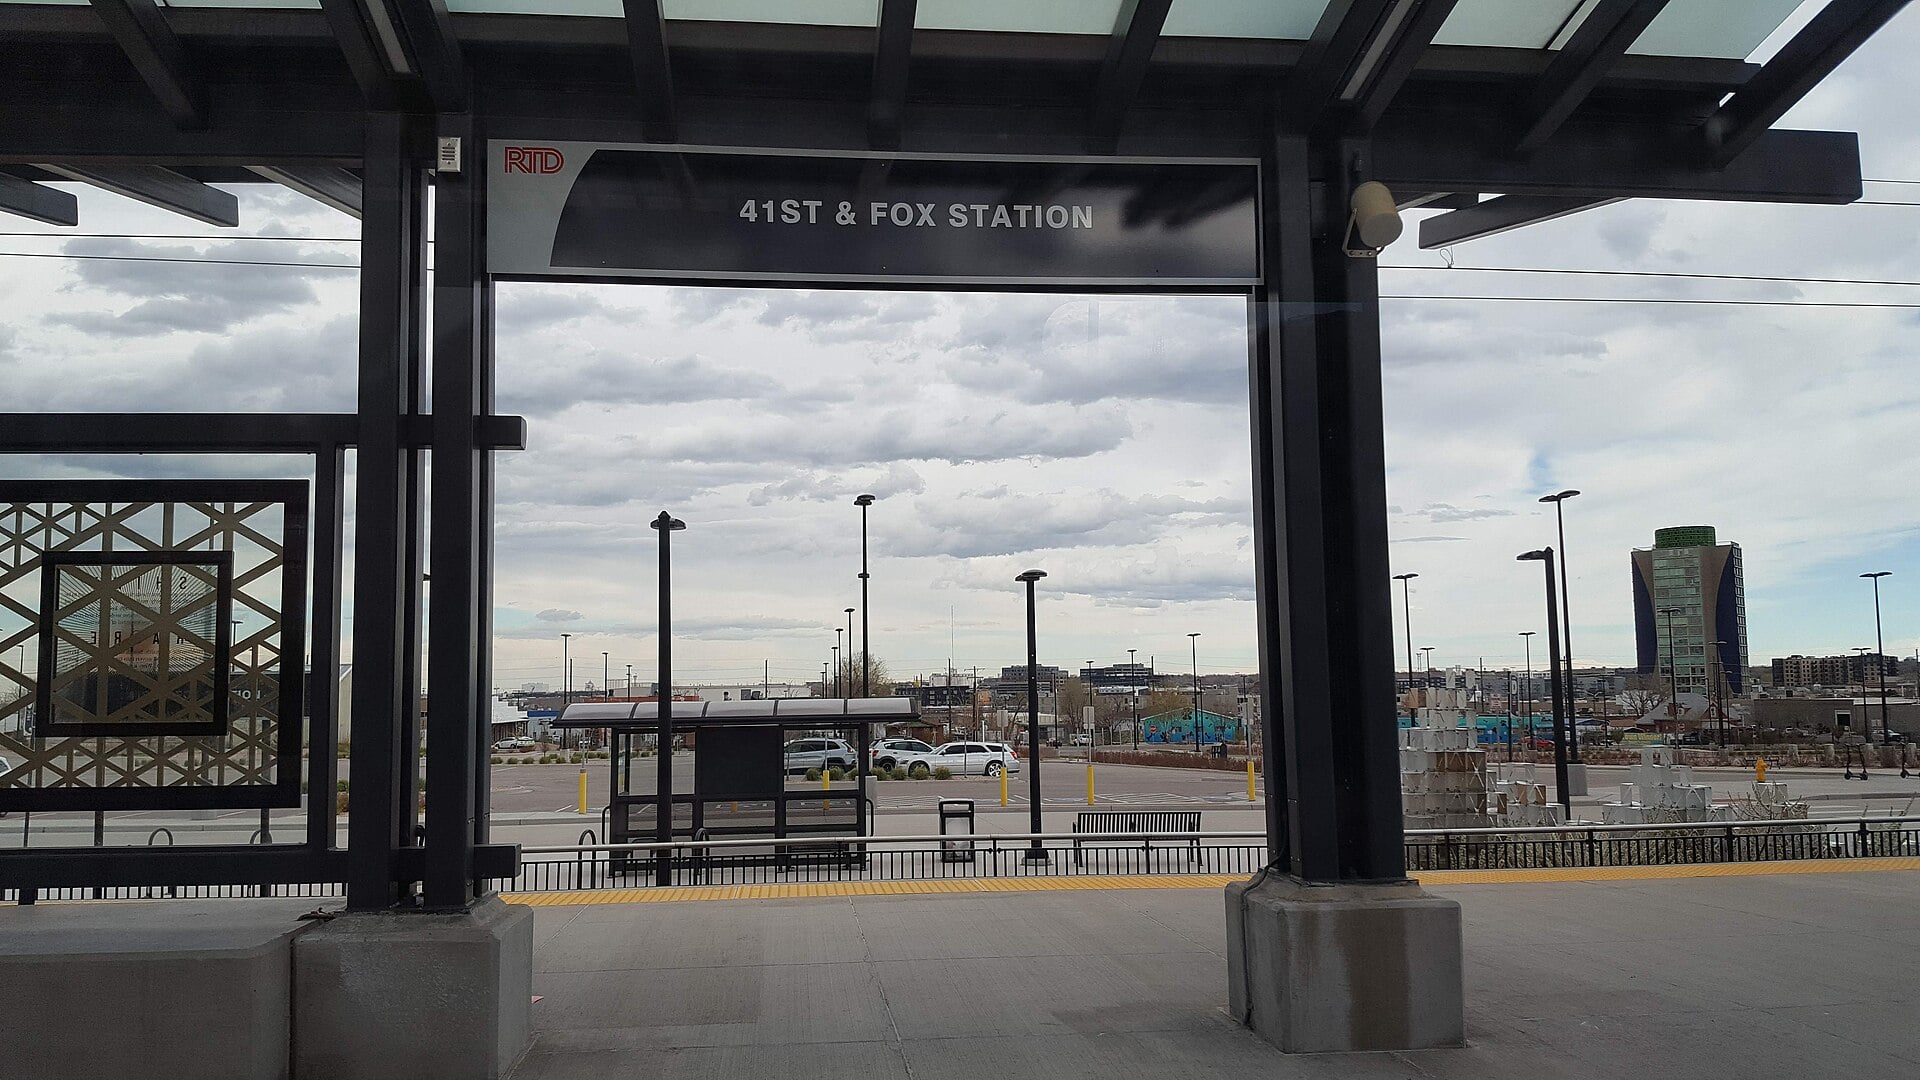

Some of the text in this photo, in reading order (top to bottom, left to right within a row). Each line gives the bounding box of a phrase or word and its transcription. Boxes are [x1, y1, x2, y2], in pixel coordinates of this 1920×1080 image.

[504, 146, 565, 174] RTD
[739, 199, 1093, 229] 41ST & FOX STATION
